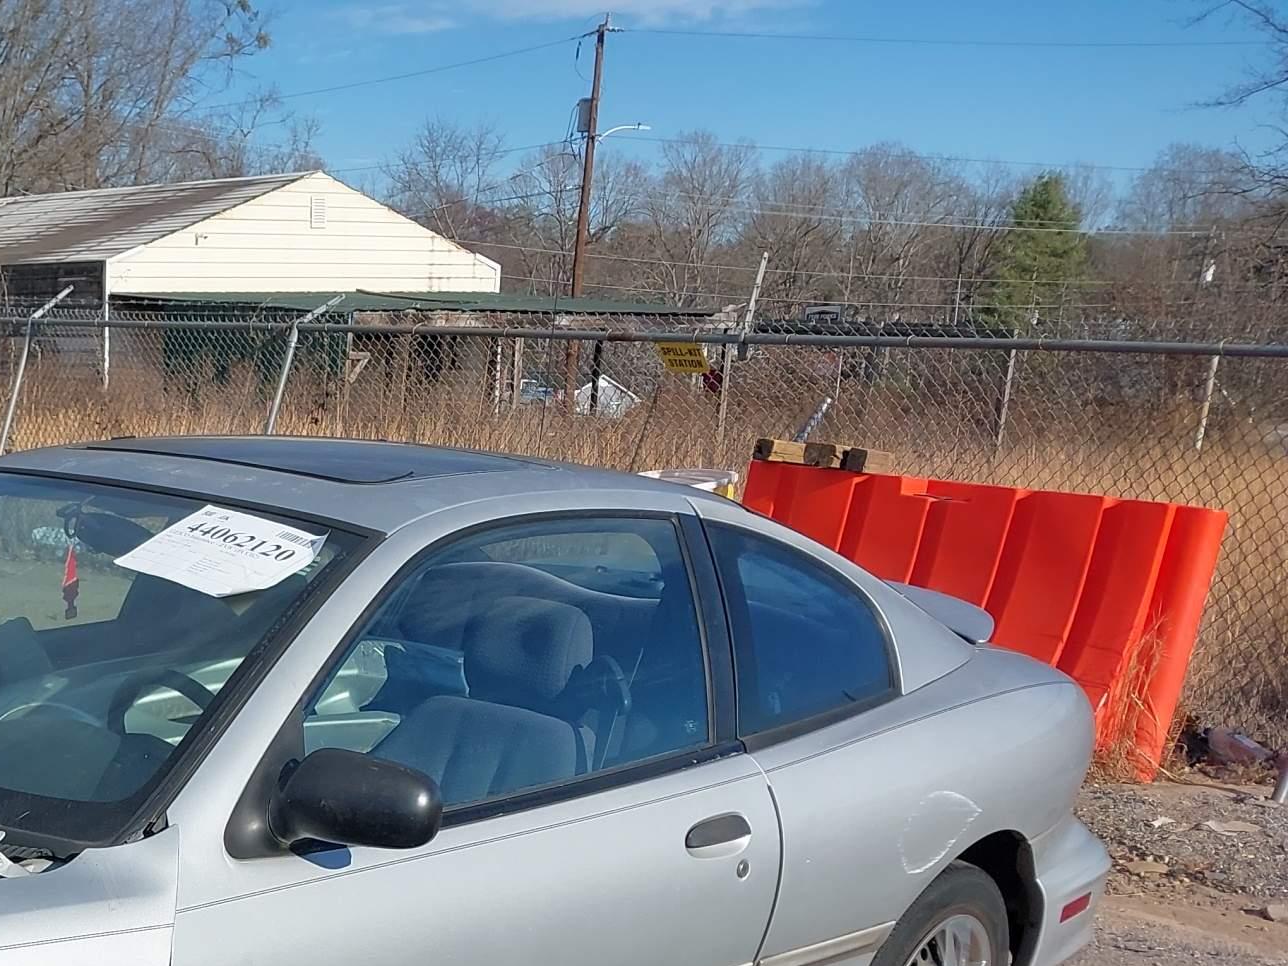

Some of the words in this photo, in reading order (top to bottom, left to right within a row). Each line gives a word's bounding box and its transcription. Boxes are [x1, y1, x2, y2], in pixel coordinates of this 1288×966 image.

[660, 346, 702, 357] SPILL-KIT
[668, 358, 703, 369] STATION
[187, 521, 296, 562] 44062120
